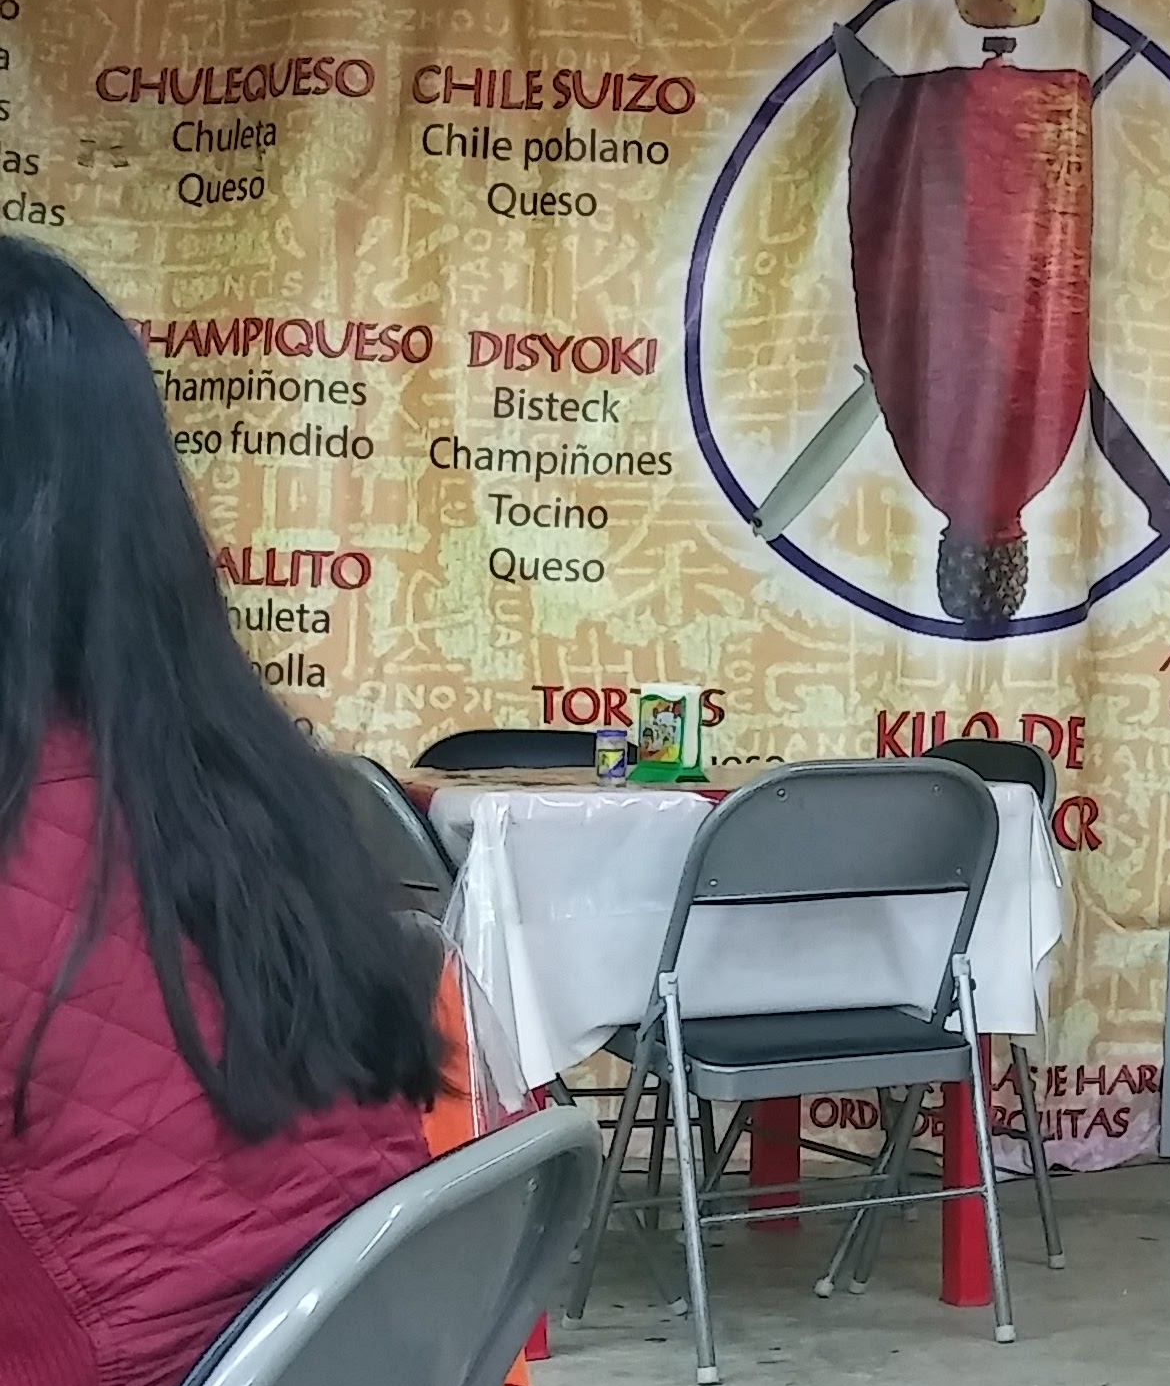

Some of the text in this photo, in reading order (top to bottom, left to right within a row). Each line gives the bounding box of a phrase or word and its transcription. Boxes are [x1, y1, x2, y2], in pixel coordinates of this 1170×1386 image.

[96, 57, 374, 106] CHULEQUESO
[413, 65, 695, 114] CHILE SUIZO
[172, 118, 277, 153] Chuleta
[423, 123, 668, 171] Chile poblano
[179, 173, 264, 207] Queso
[488, 183, 597, 219] Queso
[129, 318, 434, 364] HAMPIQUESO
[467, 330, 657, 376] DISYOKI
[153, 369, 368, 409] hampiñones
[494, 387, 620, 423] Bisteck
[174, 421, 373, 459] eso fundido
[430, 436, 672, 482] Champiñones
[488, 494, 608, 529] Tocino
[213, 546, 372, 589] ALLITO
[489, 548, 604, 584] Queso
[227, 598, 331, 635] huleta
[531, 685, 727, 727] TORS
